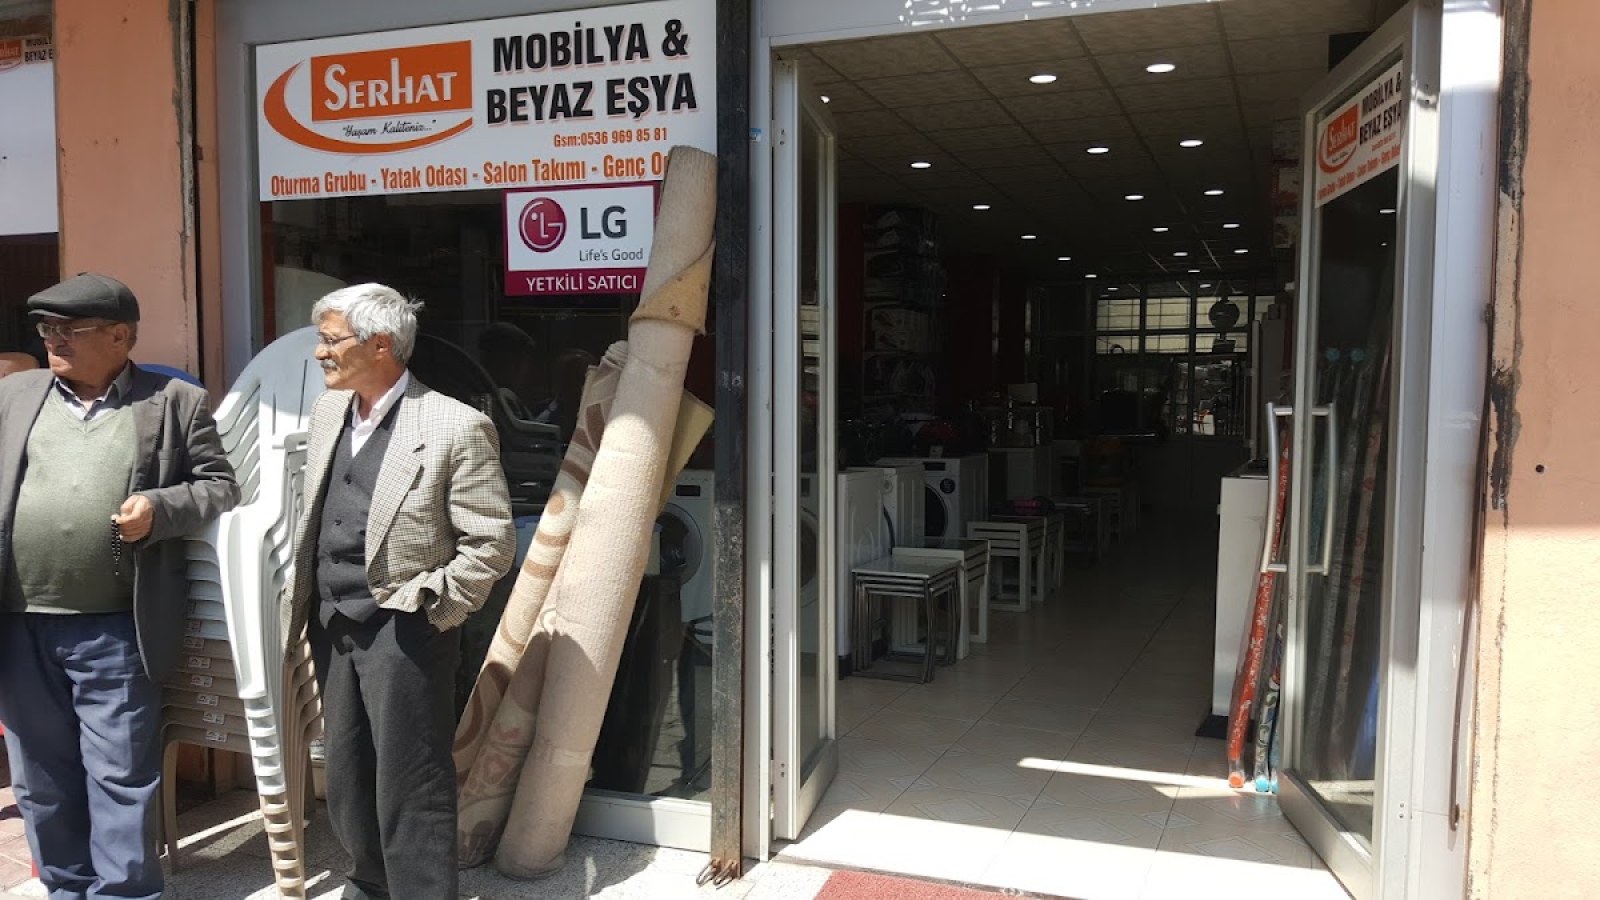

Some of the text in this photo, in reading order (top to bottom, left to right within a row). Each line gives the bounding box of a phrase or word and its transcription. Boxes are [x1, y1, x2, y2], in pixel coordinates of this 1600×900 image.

[492, 18, 689, 73] MOBİLYA &
[486, 72, 698, 125] BEYAZ EŞYA
[553, 127, 668, 148] Gsm:0536 969 85 81
[271, 174, 320, 197] Oturma
[324, 171, 366, 193] Grubu
[380, 166, 421, 190] Yatak
[426, 164, 468, 188] Odası
[483, 160, 527, 184] Salon
[532, 157, 586, 182] Takımı
[603, 154, 645, 180] Genç
[580, 205, 628, 240] LG
[579, 248, 643, 262] Life's Good
[526, 272, 637, 292] YETKİLİ SATICI
